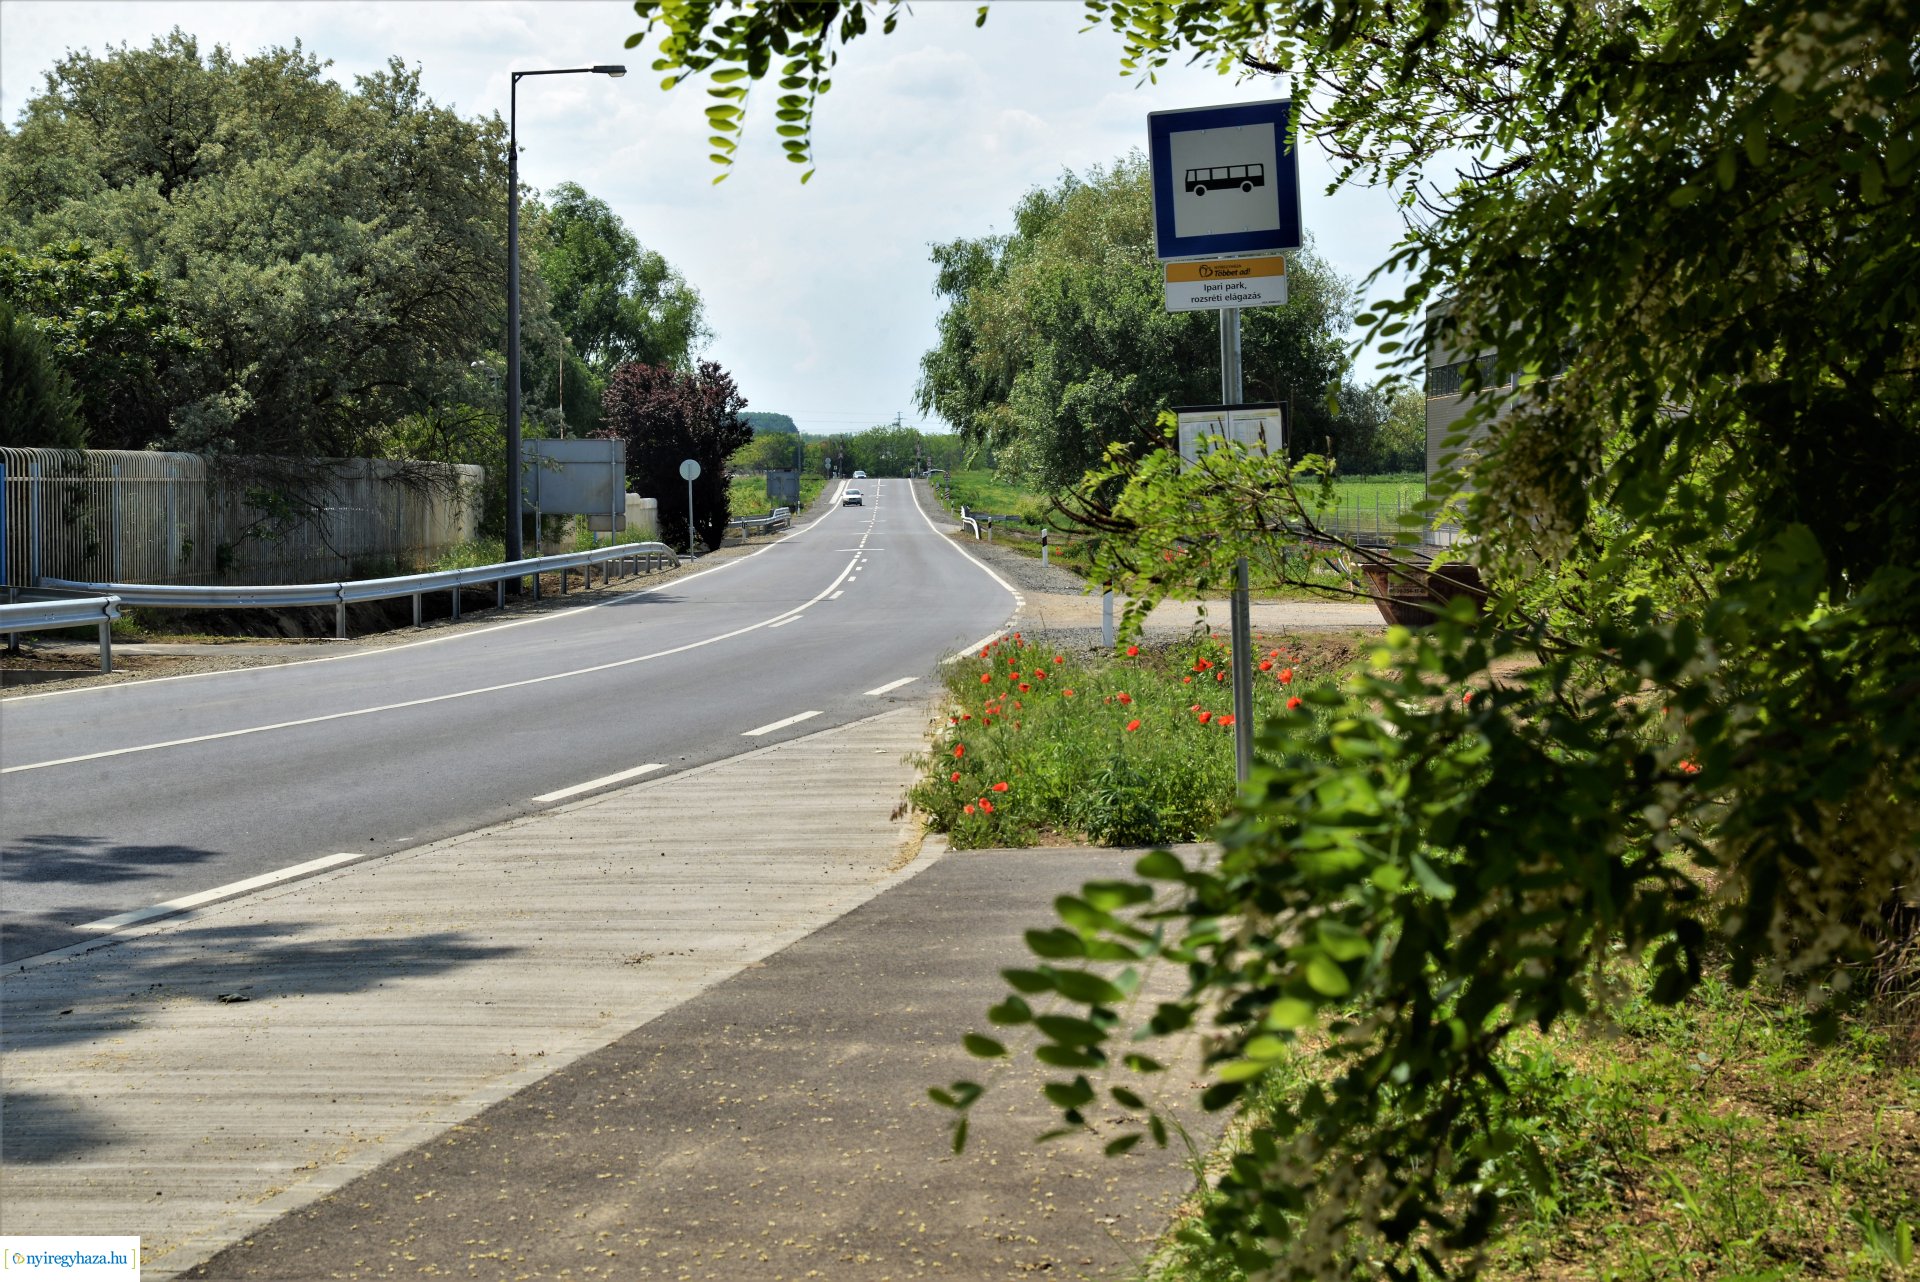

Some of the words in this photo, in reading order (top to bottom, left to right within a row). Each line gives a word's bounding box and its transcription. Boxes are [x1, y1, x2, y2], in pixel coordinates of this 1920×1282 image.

[1204, 282, 1223, 293] Ipari
[1226, 281, 1247, 292] park,
[1191, 293, 1223, 304] rozsréti
[1225, 292, 1262, 303] elágazás
